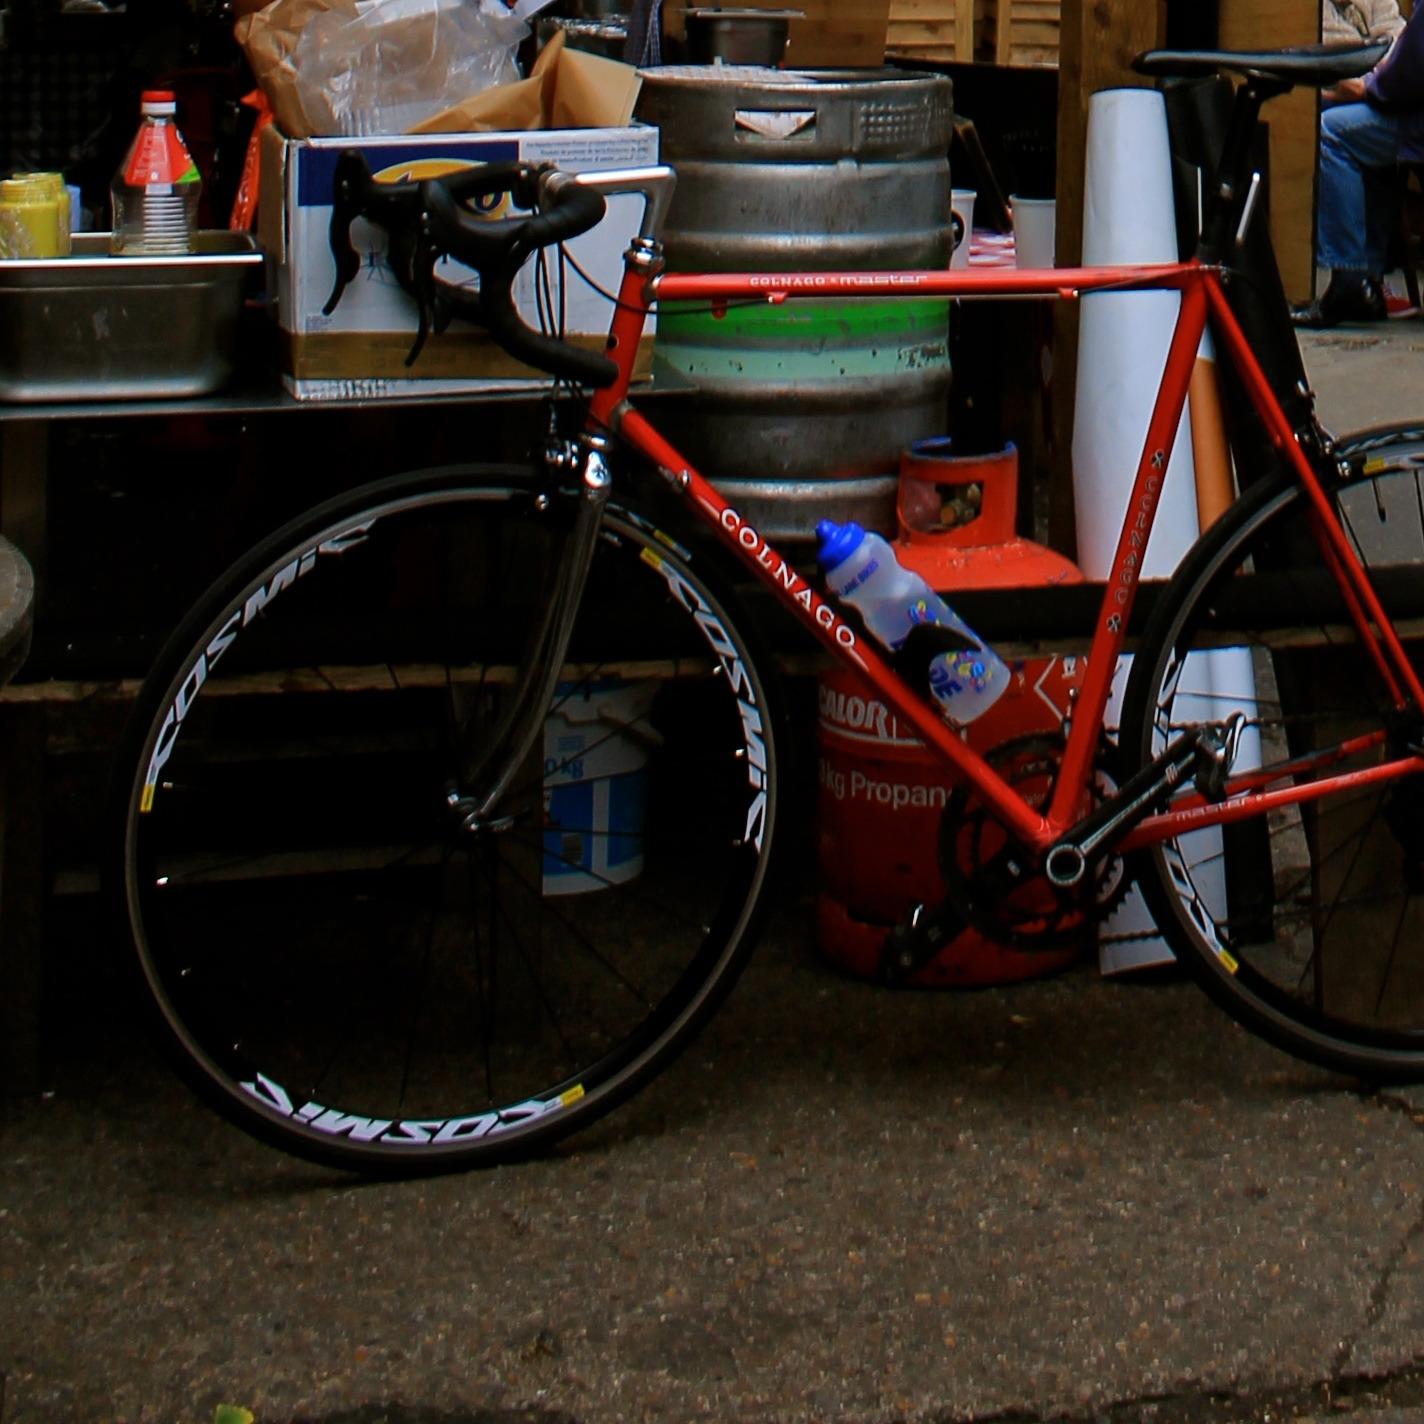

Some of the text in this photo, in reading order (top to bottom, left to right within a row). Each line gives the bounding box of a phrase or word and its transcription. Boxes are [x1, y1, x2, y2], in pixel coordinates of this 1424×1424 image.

[749, 274, 928, 287] COLNAGO master
[721, 508, 855, 648] COLNAGO
[851, 769, 953, 812] Propan
